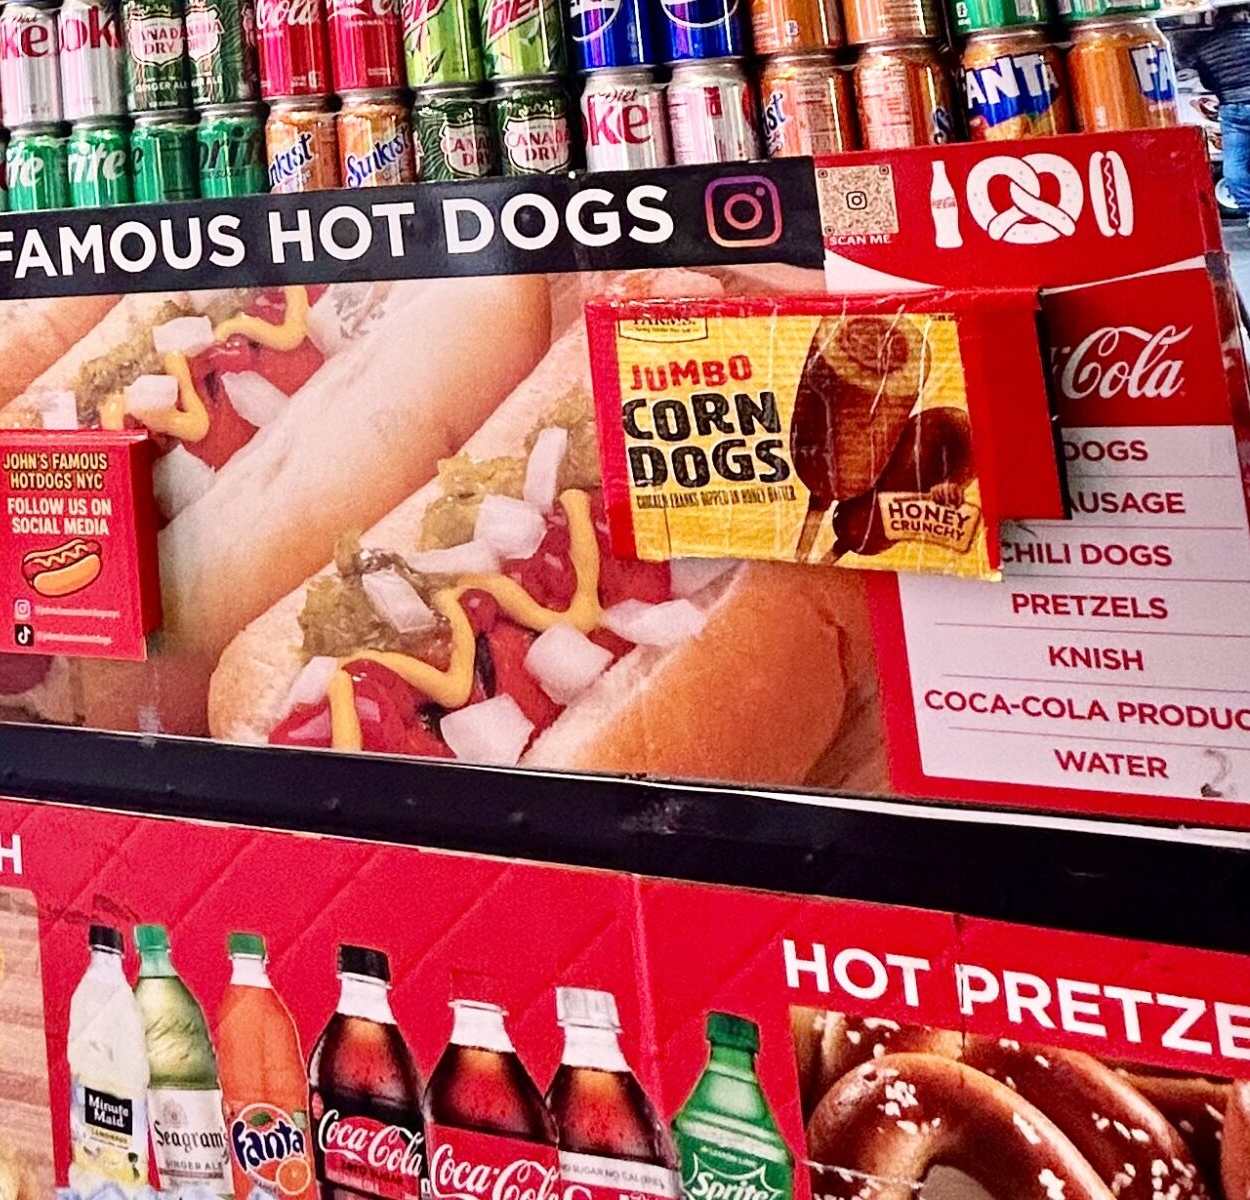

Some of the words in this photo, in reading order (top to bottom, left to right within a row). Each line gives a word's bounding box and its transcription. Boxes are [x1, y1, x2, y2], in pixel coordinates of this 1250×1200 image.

[144, 39, 176, 56] DRY
[524, 145, 560, 162] DRY
[268, 201, 417, 264] HOT
[441, 184, 675, 255] DOGS
[829, 234, 867, 246] SCAN
[869, 233, 892, 245] ME
[629, 354, 753, 392] JUMBO
[622, 390, 782, 442] CORN
[3, 453, 49, 470] JOHN'S
[51, 453, 109, 470] FAMOUS
[1064, 440, 1149, 462] DOGS
[627, 438, 791, 489] DOGS
[10, 472, 73, 490] HOTDOGS
[76, 473, 104, 490] NYC
[7, 497, 65, 516] FOLLOW
[68, 497, 88, 516] US
[91, 498, 113, 517] ON
[669, 492, 699, 510] FRANKS
[11, 516, 62, 535] SOCIAL
[63, 518, 110, 536] MEDIA
[888, 502, 971, 531] HONEY
[890, 519, 966, 544] CRUNCHY
[1081, 544, 1173, 567] DOGS
[1011, 592, 1169, 620] PRETZELS
[1047, 645, 1145, 672] KNISH
[924, 689, 1110, 723] COCA-COLA
[1054, 748, 1170, 779] WATER
[781, 938, 931, 1008] HOT
[954, 962, 1250, 1061] PRETZE
[88, 1094, 130, 1118] Minute
[93, 1107, 125, 1128] Maid
[318, 1108, 424, 1177] Coca-Cola
